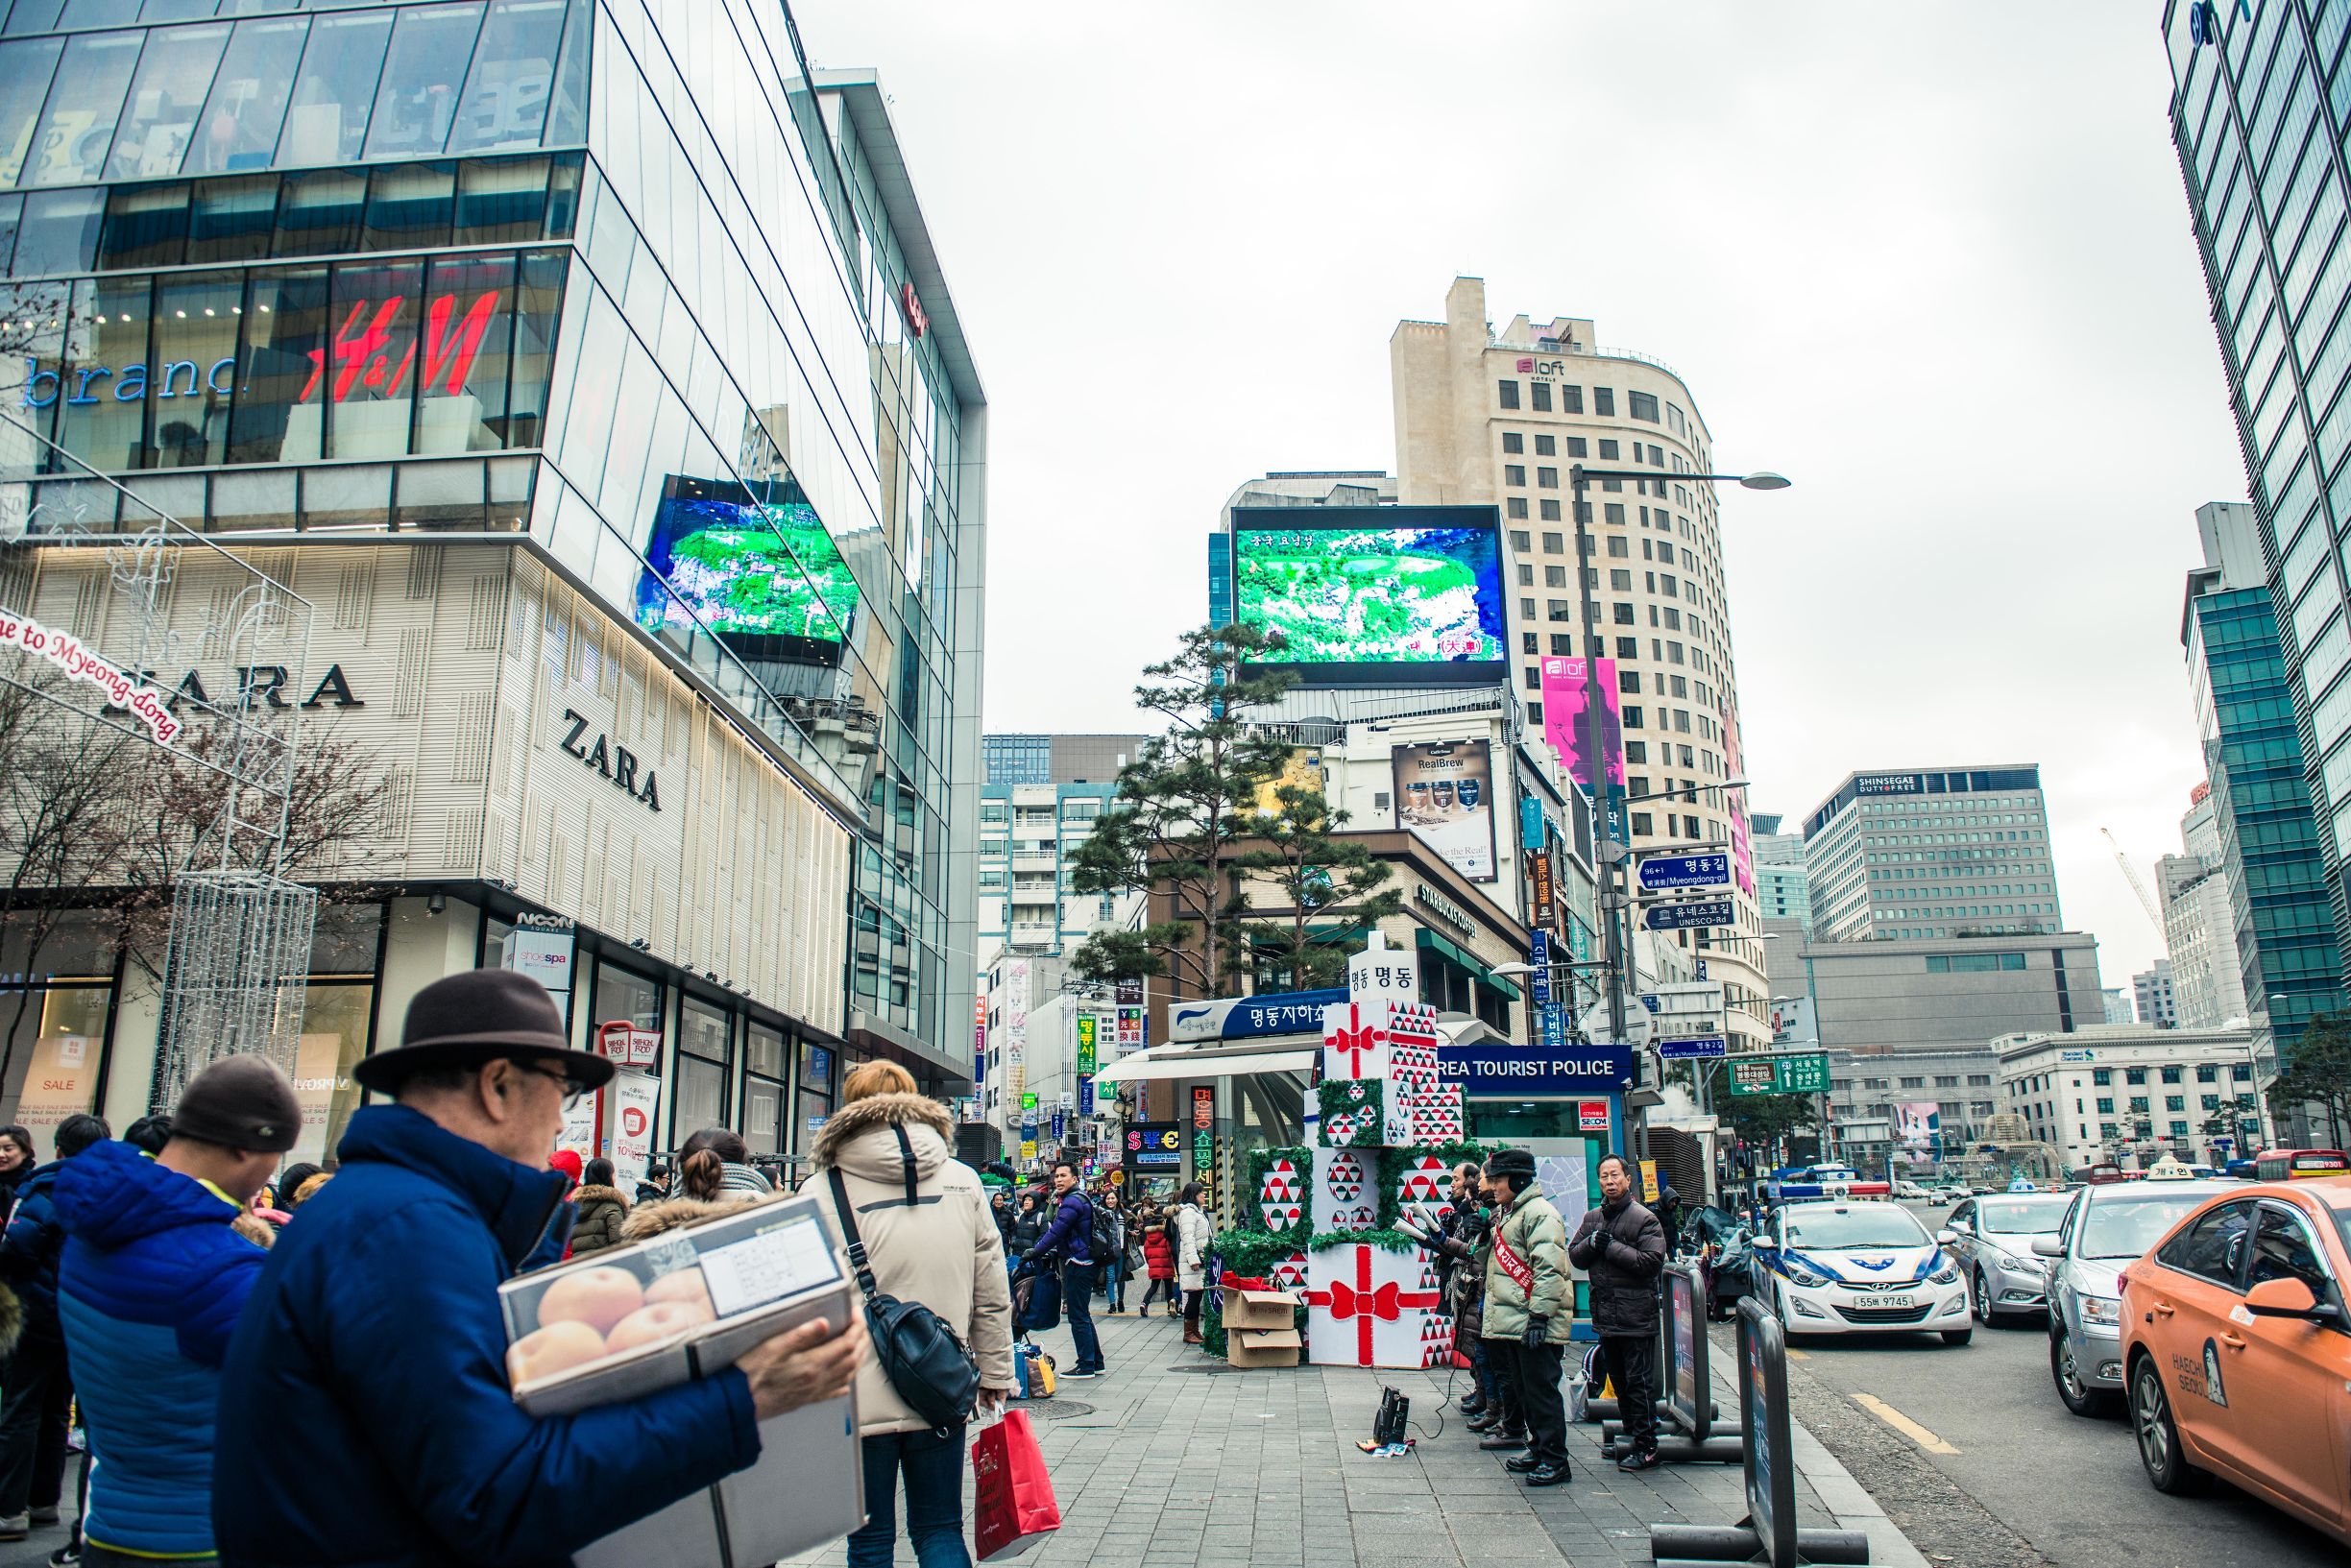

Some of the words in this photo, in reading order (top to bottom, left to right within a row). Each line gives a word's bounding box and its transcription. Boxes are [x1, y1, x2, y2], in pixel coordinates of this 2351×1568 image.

[300, 290, 498, 403] H&M
[1516, 358, 1564, 375] aloft
[1250, 535, 1273, 547] 중국
[1545, 660, 1587, 676] alof
[23, 625, 45, 649] to
[50, 635, 178, 741] Myeong-dong
[563, 708, 663, 812] ZARA
[1418, 758, 1464, 769] RealBrew
[1859, 776, 1915, 785] SHINSEGAE
[1450, 846, 1464, 855] the
[1465, 845, 1487, 855] Real!
[1685, 857, 1725, 873] 명동길
[1421, 883, 1458, 925] STARBUCKS
[1676, 904, 1730, 917] 유네스코길
[1679, 916, 1727, 927] UNESCO-Rd
[521, 952, 566, 964] shoespa
[1351, 968, 1368, 992] 명동
[1374, 966, 1413, 988] 명동
[1250, 1002, 1325, 1028] 명동지하쇼
[1697, 1041, 1723, 1049] 명동2길
[1435, 1061, 1469, 1075] REA
[1472, 1060, 1547, 1076] TOURIST
[1552, 1060, 1613, 1075] POLICE
[1736, 1071, 1770, 1079] 명동대성당
[43, 1079, 75, 1091] SALE
[1797, 1073, 1821, 1081] 숭례문
[1194, 1089, 1213, 1129] 명동
[1883, 1296, 1908, 1307] 9745
[2172, 1352, 2204, 1378] HAECHI
